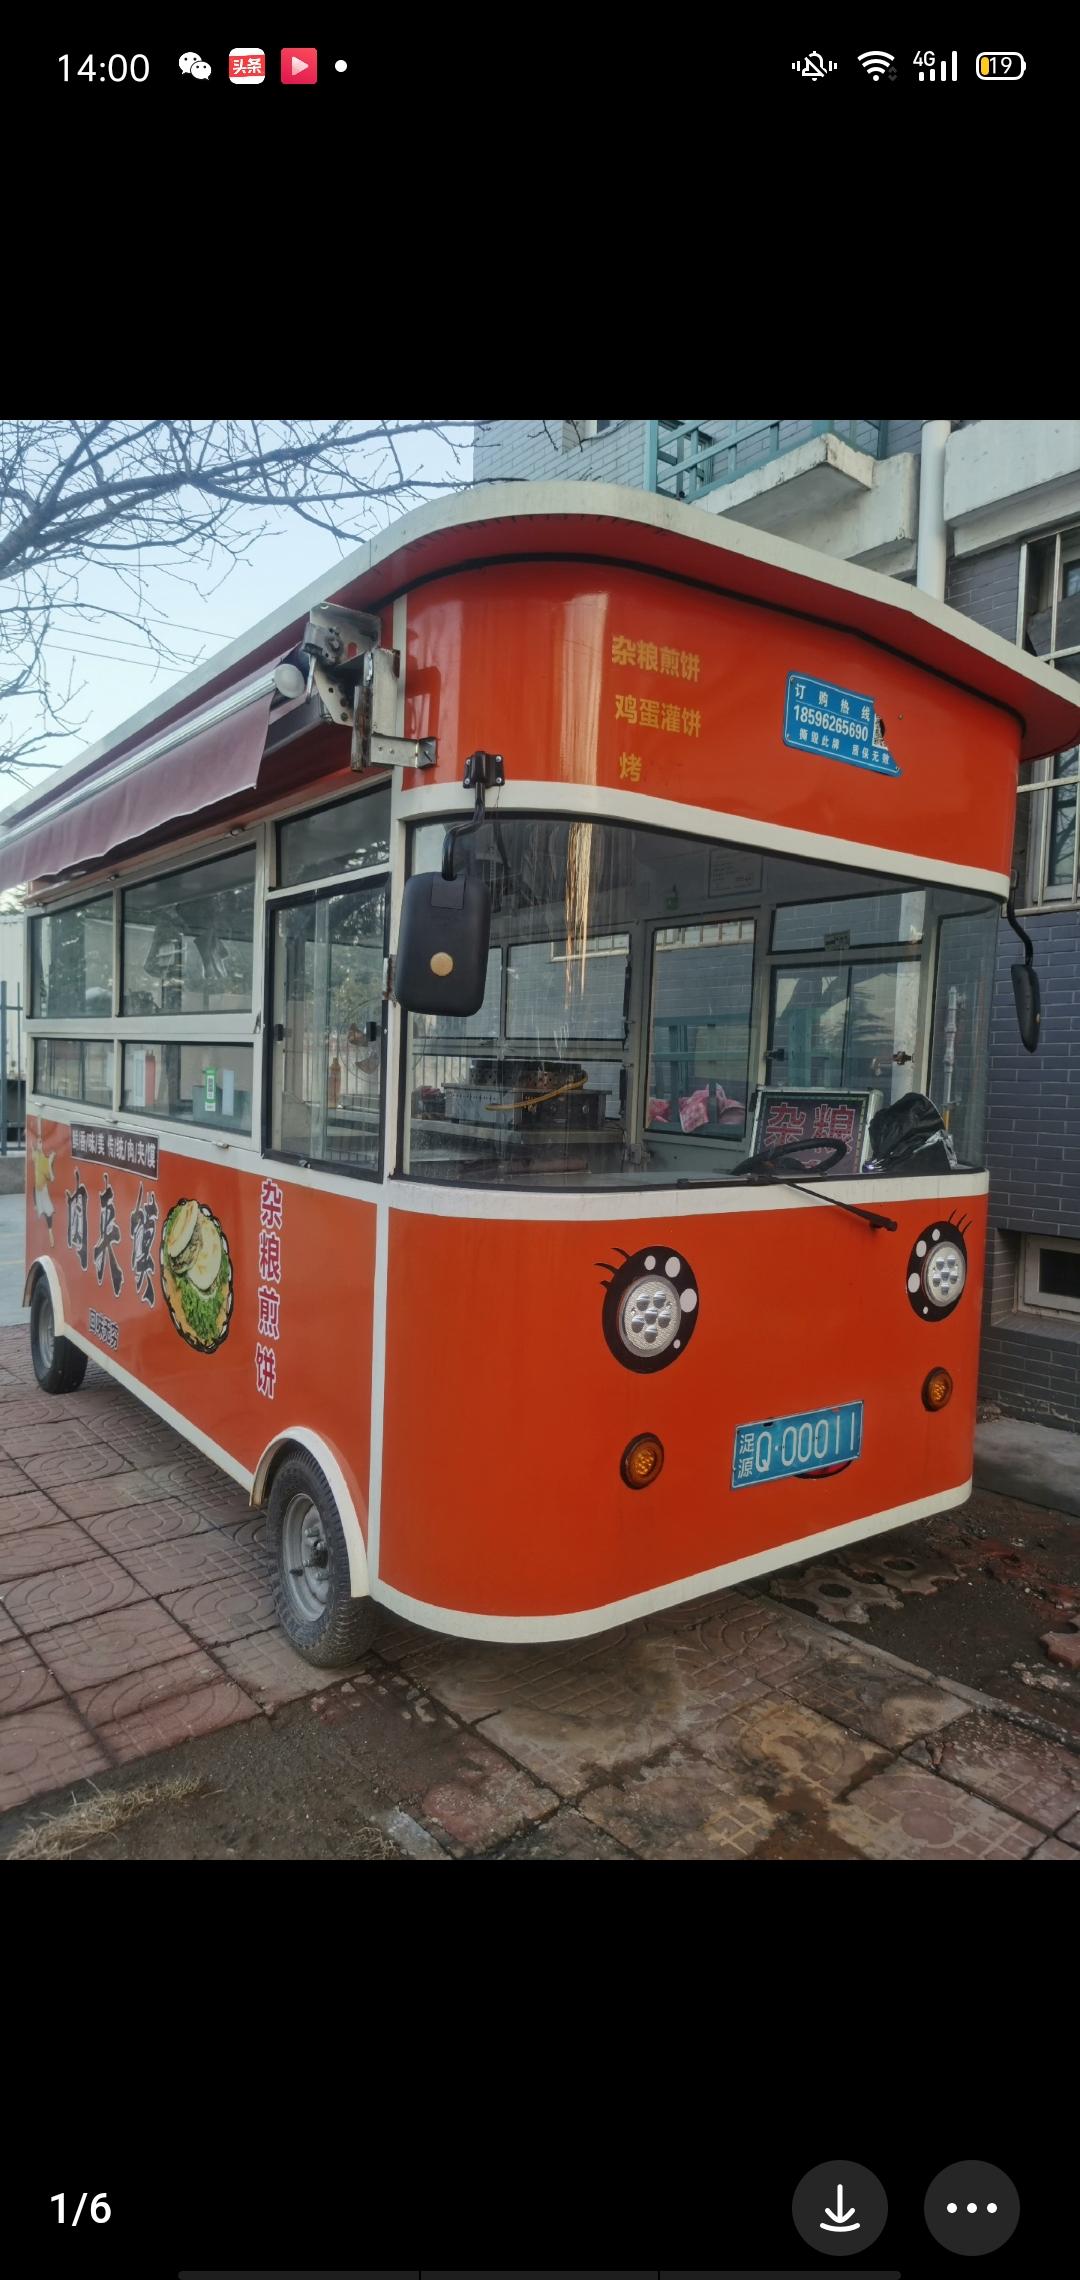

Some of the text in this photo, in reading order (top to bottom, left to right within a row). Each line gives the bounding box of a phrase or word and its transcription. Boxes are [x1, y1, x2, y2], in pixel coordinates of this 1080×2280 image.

[611, 635, 700, 682] 杂粮煎饼
[614, 694, 702, 738] 鸡蛋灌饼
[793, 704, 869, 742] 18596265690
[794, 682, 871, 723] 订购热线
[619, 751, 643, 783] 烤
[65, 1167, 160, 1308] 肉夹馍
[254, 1178, 283, 1400] 杂粮煎饼
